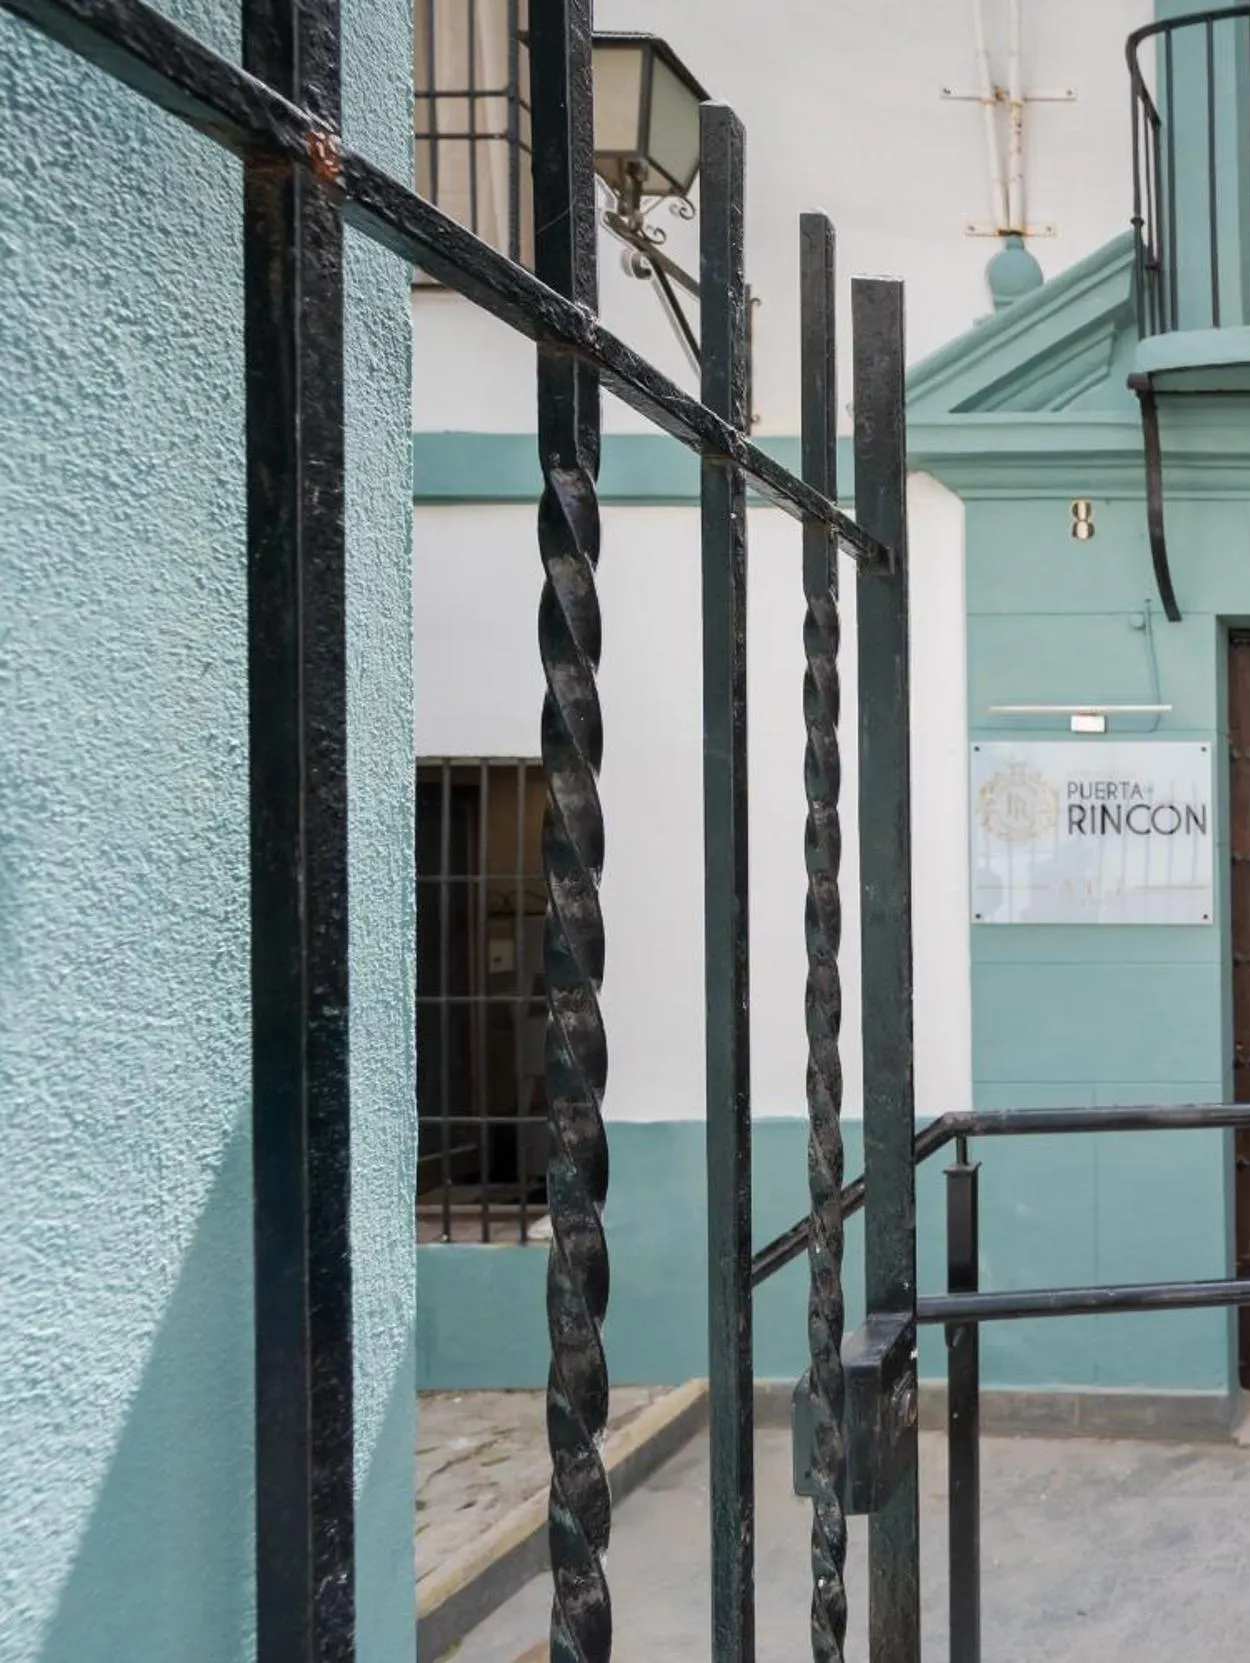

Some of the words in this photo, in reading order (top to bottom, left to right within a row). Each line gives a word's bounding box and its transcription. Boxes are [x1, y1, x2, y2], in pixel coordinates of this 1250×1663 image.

[1071, 499, 1095, 541] 8
[1067, 781, 1144, 800] PUERTA
[1067, 803, 1207, 835] RINCON
